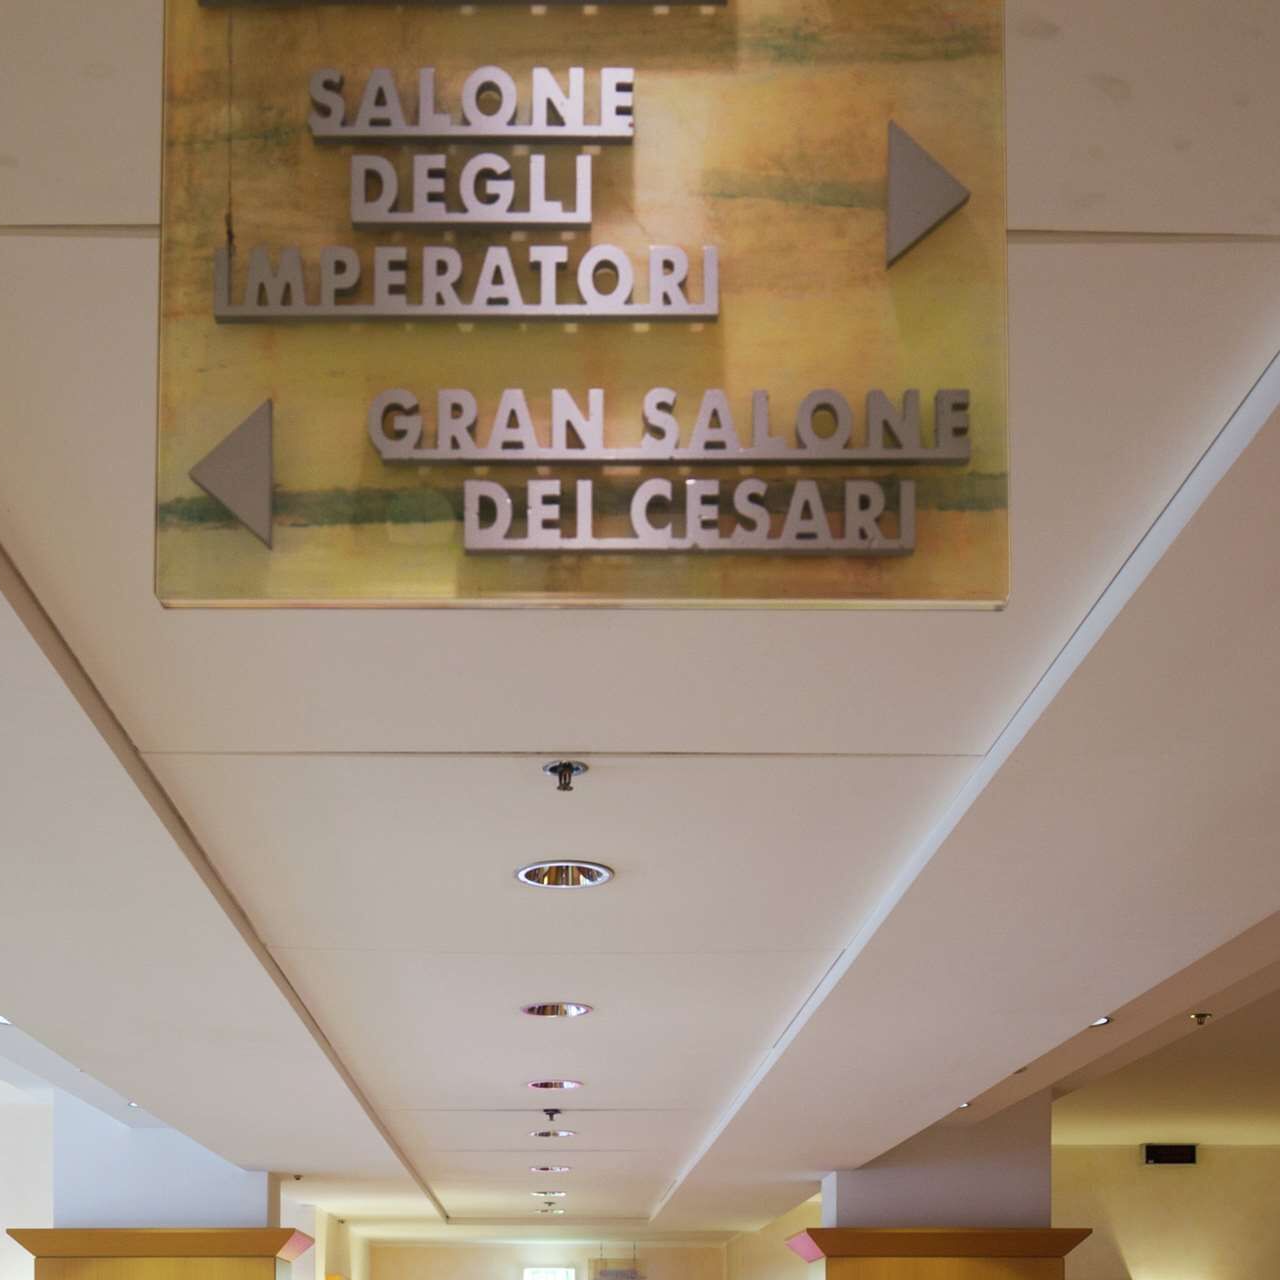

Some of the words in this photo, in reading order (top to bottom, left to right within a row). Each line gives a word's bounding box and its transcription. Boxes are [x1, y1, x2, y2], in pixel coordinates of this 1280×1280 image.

[308, 65, 635, 140] SALONE
[351, 152, 592, 226] DEGLI
[213, 243, 719, 320] IMPERATORI
[367, 387, 605, 462] GRAN
[640, 386, 971, 464] SALONE
[463, 478, 593, 550] DEI
[630, 478, 916, 553] CESARI
